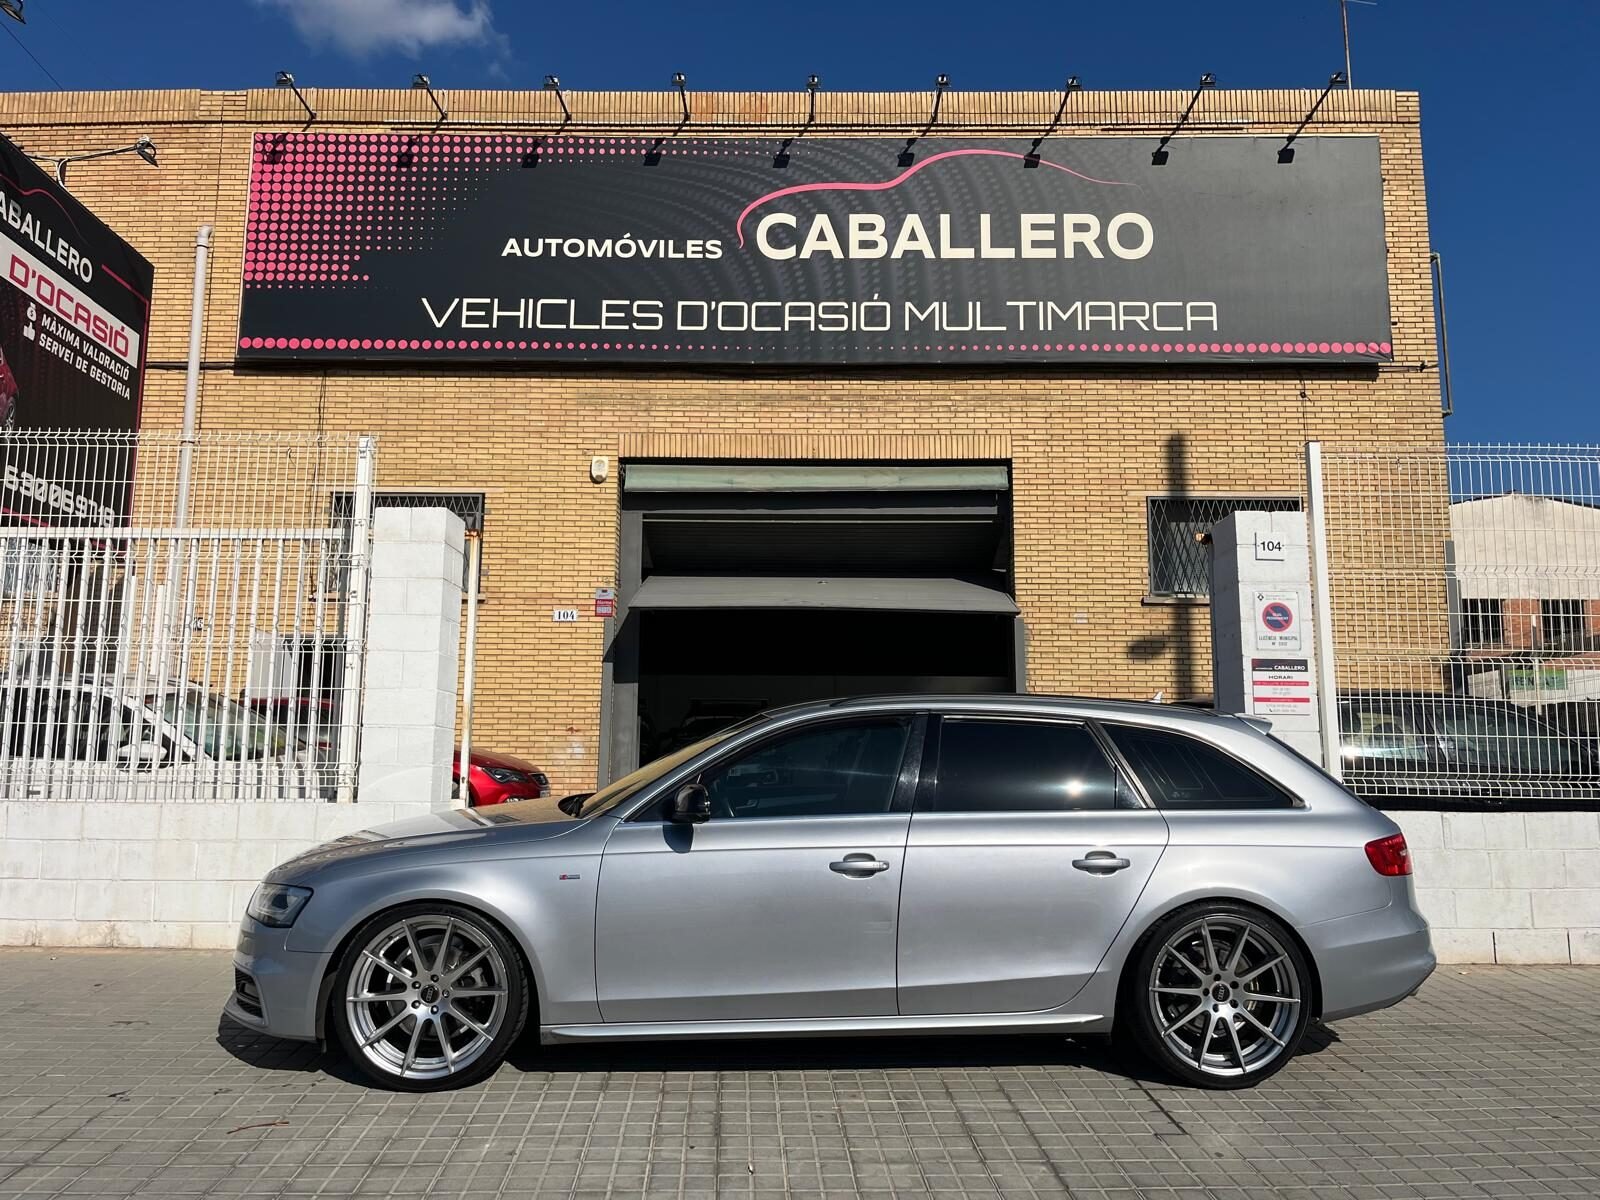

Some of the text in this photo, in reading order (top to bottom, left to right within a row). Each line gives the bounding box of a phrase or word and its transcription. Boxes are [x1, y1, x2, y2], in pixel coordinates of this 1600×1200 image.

[501, 213, 1154, 260] AUTOMÓVILES CABALLERO
[9, 253, 129, 358] D'OCASIÓ
[421, 294, 1218, 333] VEHICLES D'OCASIÓ MULTIMARCA
[39, 333, 131, 401] SERVEI DE GESTORIA
[41, 313, 130, 381] MÀXIMA VALORACIÓ
[1260, 540, 1282, 552] 104
[557, 610, 575, 620] 104
